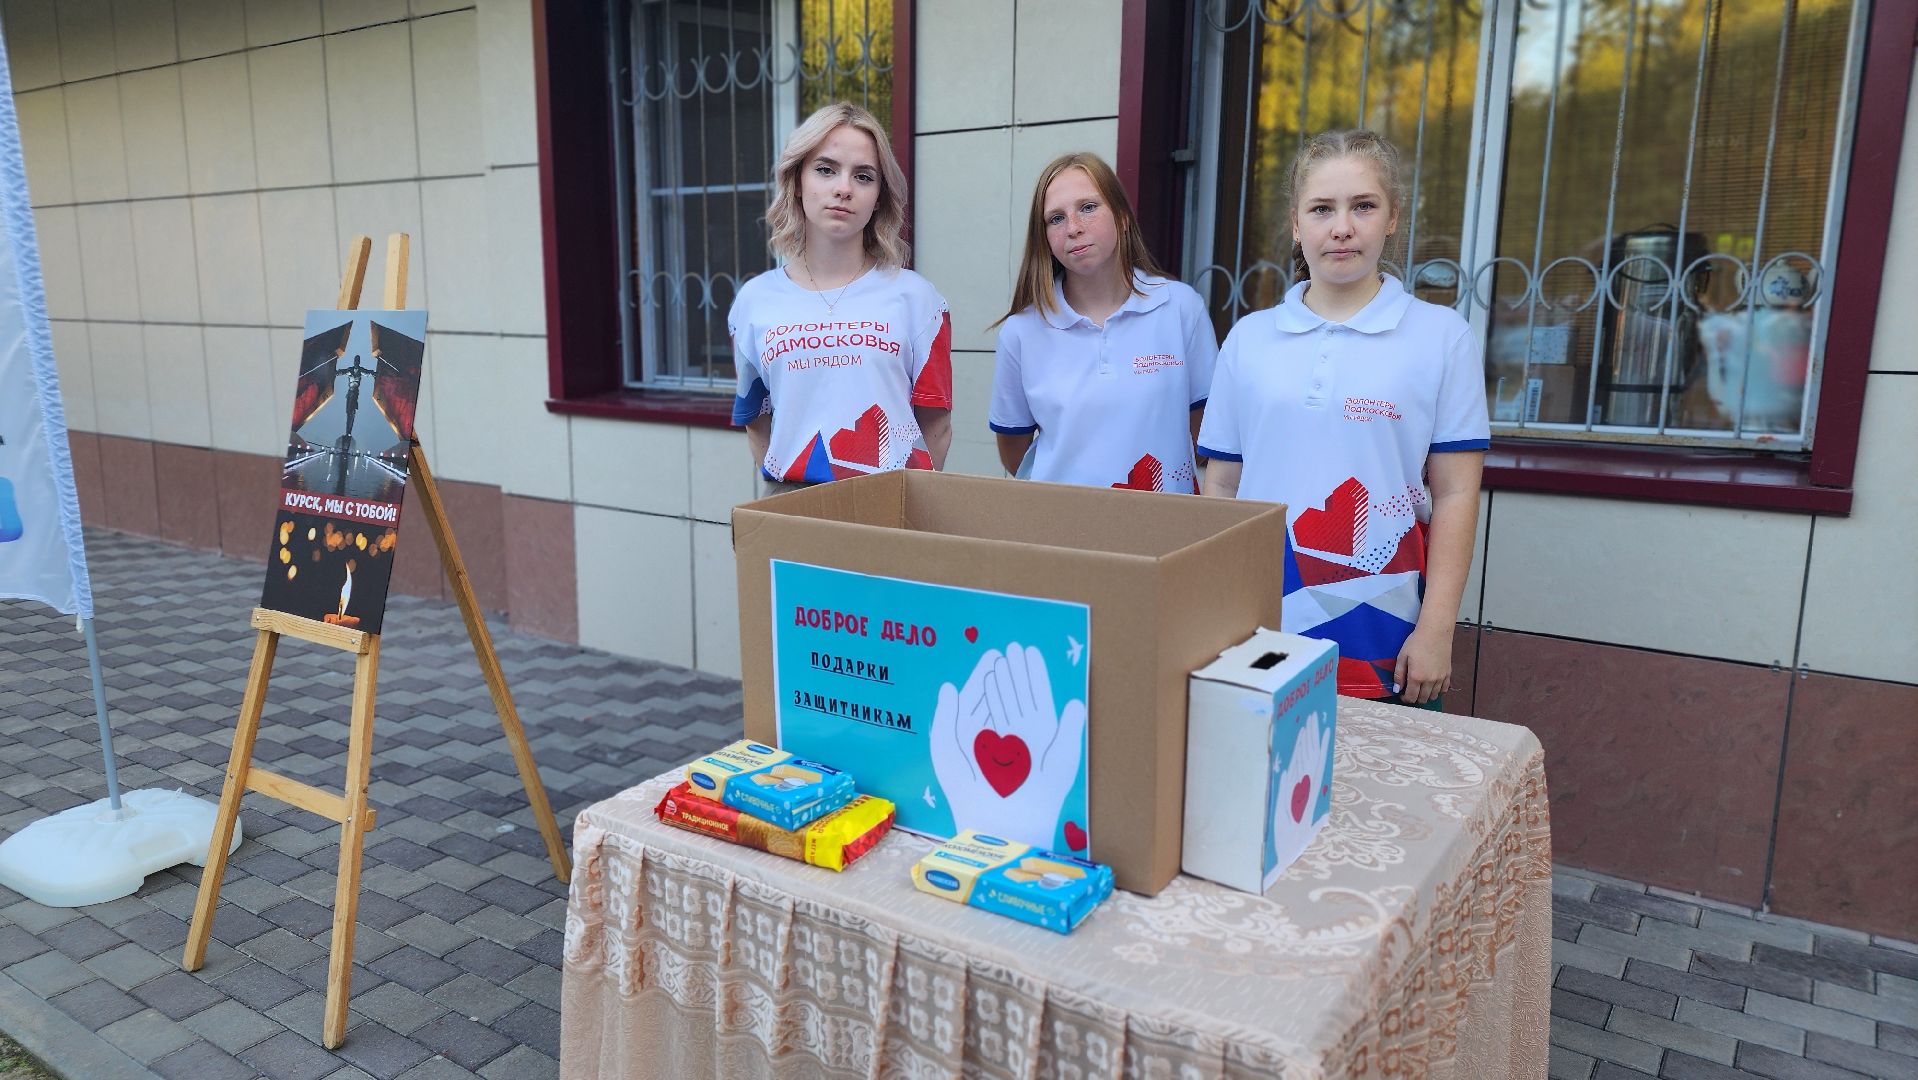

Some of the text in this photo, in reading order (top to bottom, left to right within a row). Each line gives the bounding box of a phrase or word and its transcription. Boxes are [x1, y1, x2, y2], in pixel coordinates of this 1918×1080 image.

[766, 321, 889, 345] ВОЛОНТЕРЫ
[761, 333, 900, 369] ПОДМОСКОВЬЯ
[788, 354, 861, 371] МЫ РЯДОМ
[285, 492, 397, 522] КУРСК, МЫ С ТОБОЙ!
[795, 606, 936, 647] ДОБРОЕ ДЕЛО
[811, 652, 889, 681] ПОДАРКИ
[794, 690, 912, 730] ЗАЩИТНИКАМ
[682, 812, 729, 831] ТРАДИЦИОННОЕ
